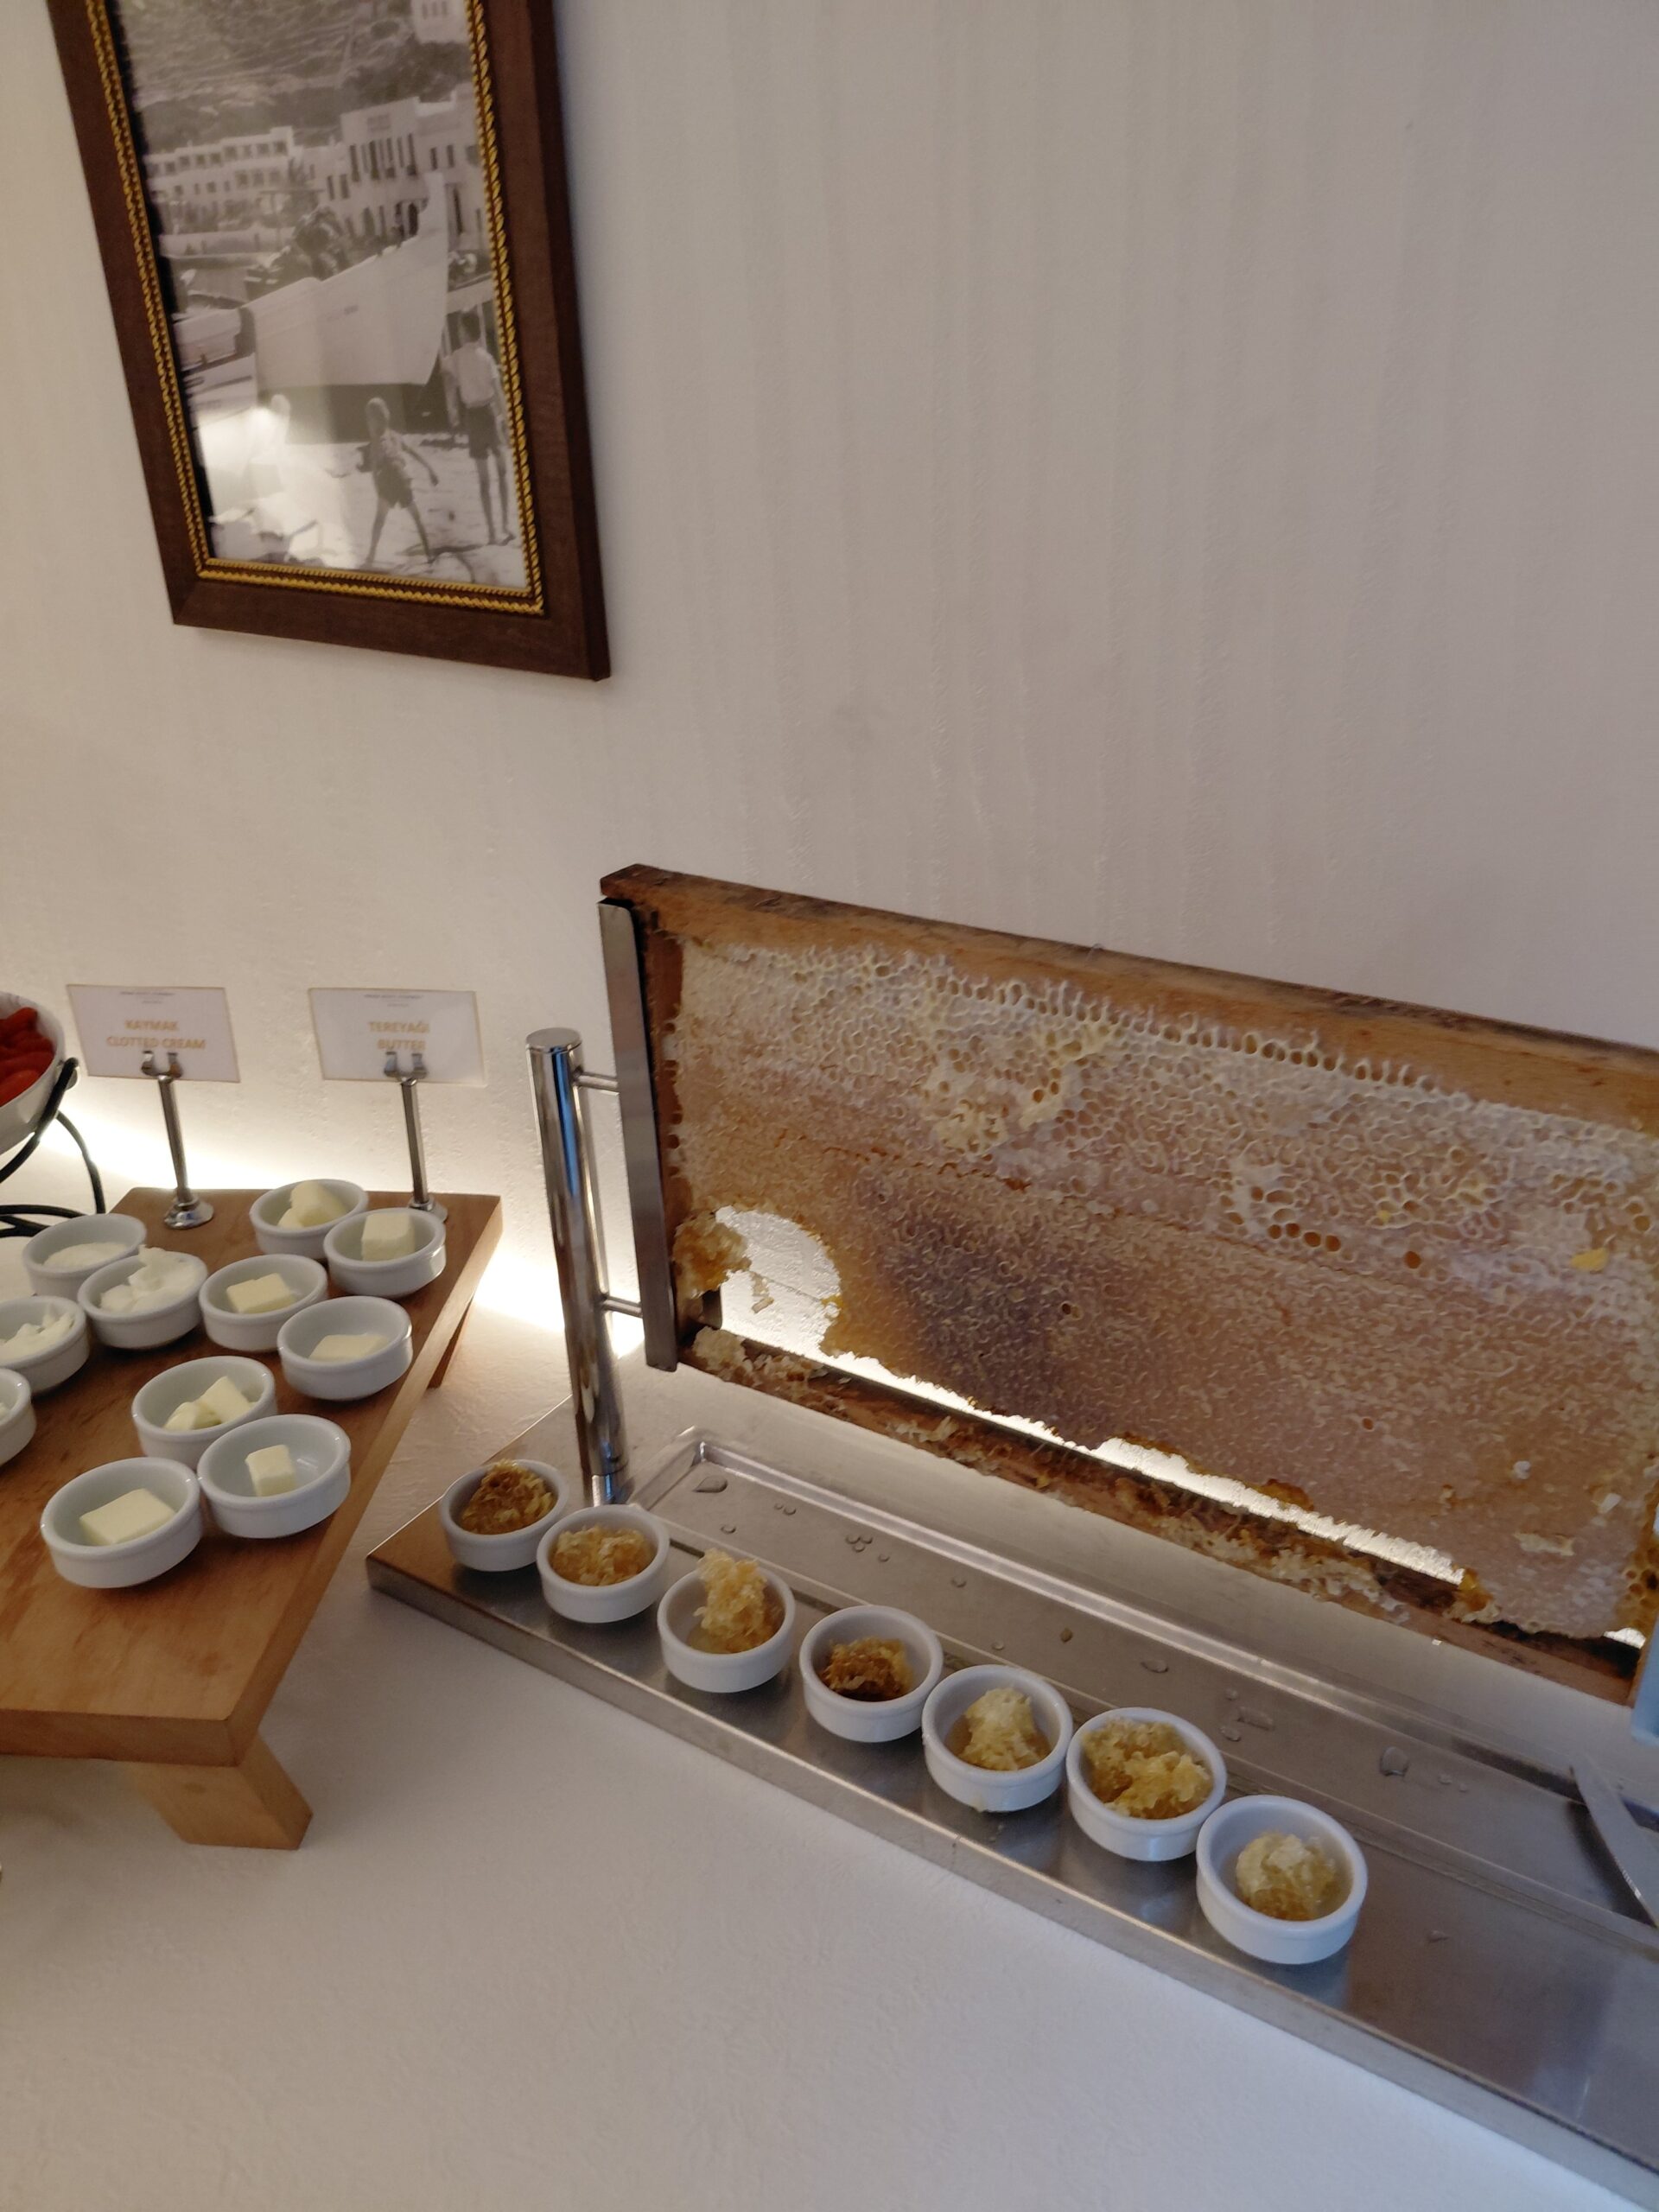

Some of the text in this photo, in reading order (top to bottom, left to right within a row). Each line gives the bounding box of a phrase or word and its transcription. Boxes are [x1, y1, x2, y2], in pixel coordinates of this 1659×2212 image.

[124, 1019, 179, 1032] KAYMAK
[105, 1035, 207, 1050] CLOTTED CREAM
[377, 1039, 427, 1051] BUTTER
